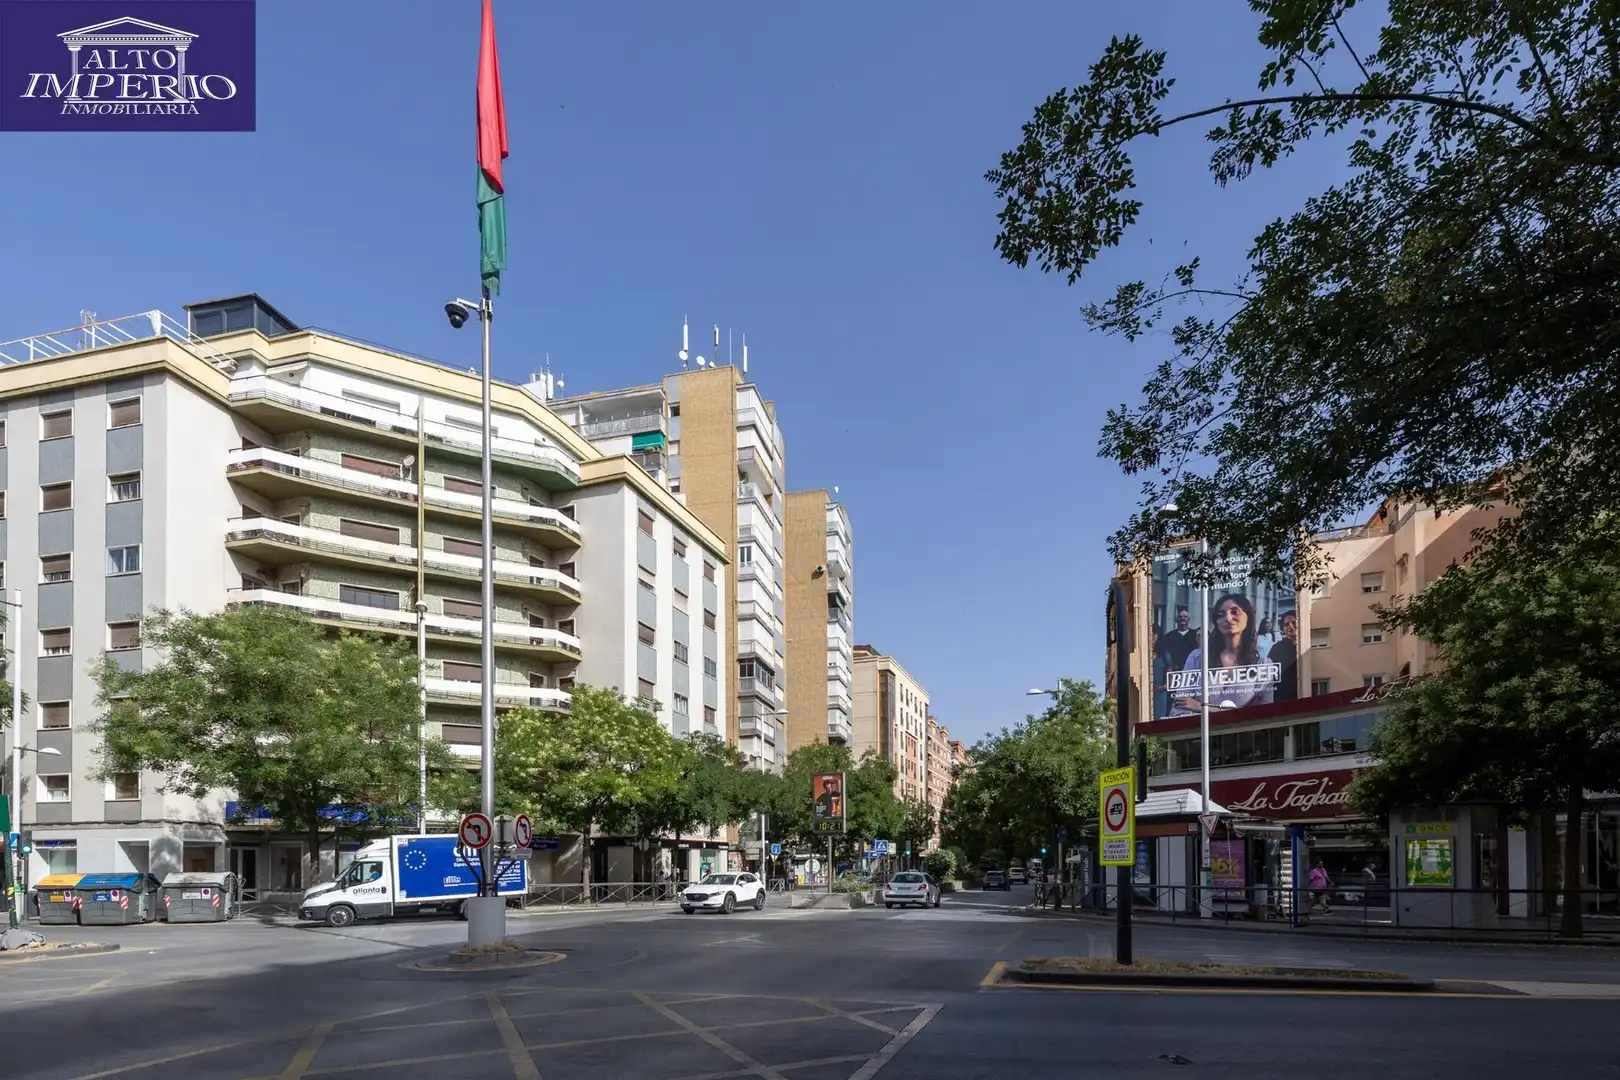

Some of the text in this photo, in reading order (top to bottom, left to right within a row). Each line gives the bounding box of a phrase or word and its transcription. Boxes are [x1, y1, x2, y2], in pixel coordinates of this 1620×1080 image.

[1211, 578, 1249, 590] mundo?
[1103, 772, 1129, 784] ATENCIÓN
[1227, 781, 1268, 811] La
